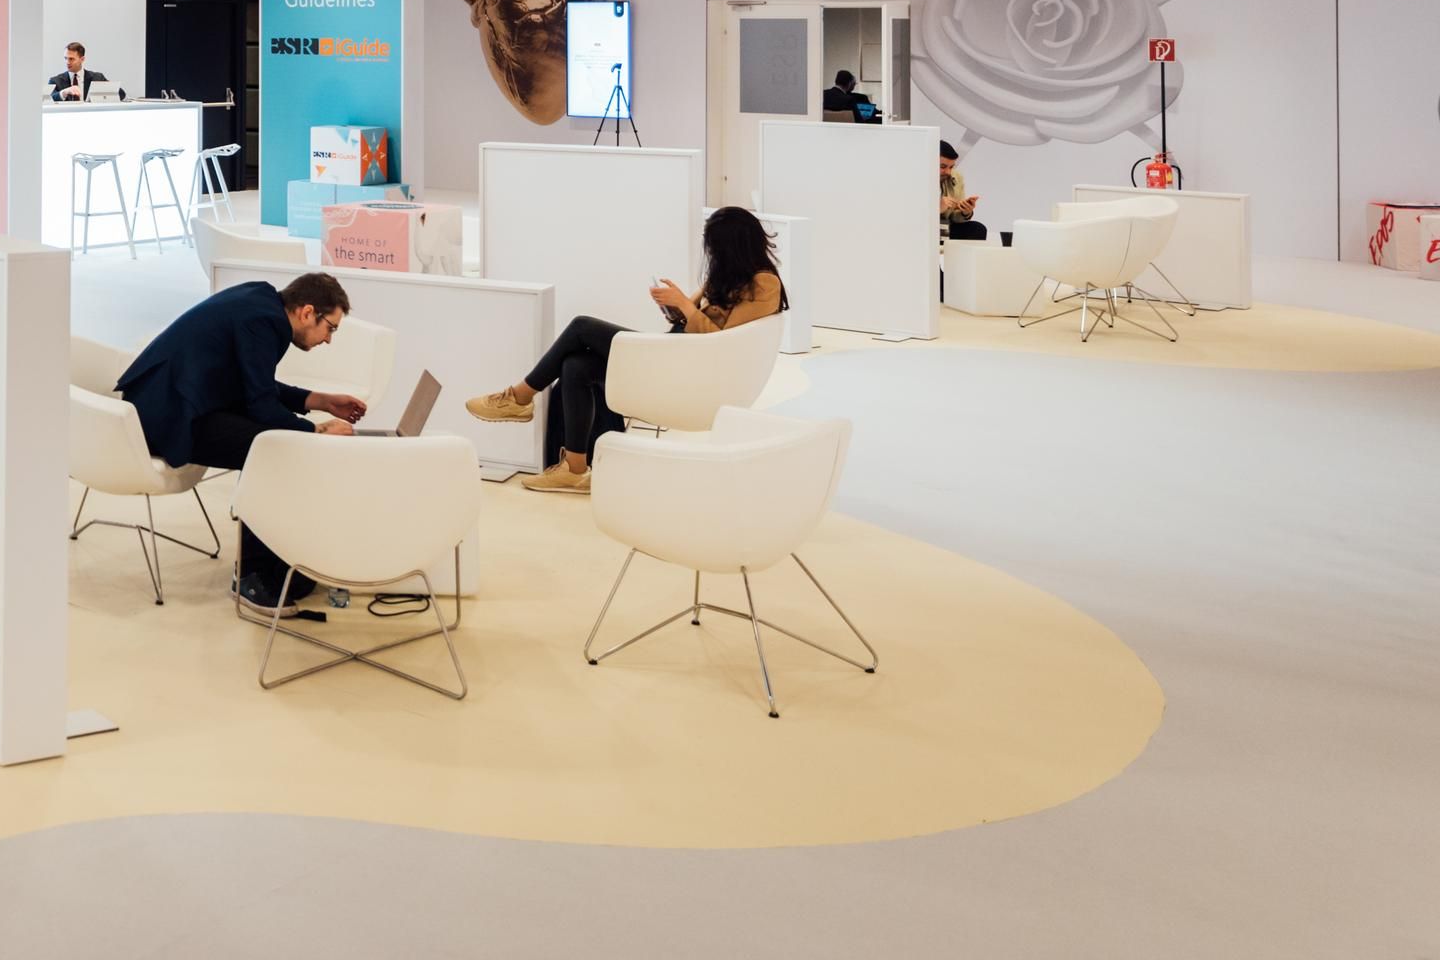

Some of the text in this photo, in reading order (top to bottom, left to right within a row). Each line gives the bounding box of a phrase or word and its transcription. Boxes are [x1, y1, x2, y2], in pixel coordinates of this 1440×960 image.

[271, 37, 390, 56] ESR iGuide
[341, 236, 387, 247] HOME OF
[335, 246, 394, 265] the smart
